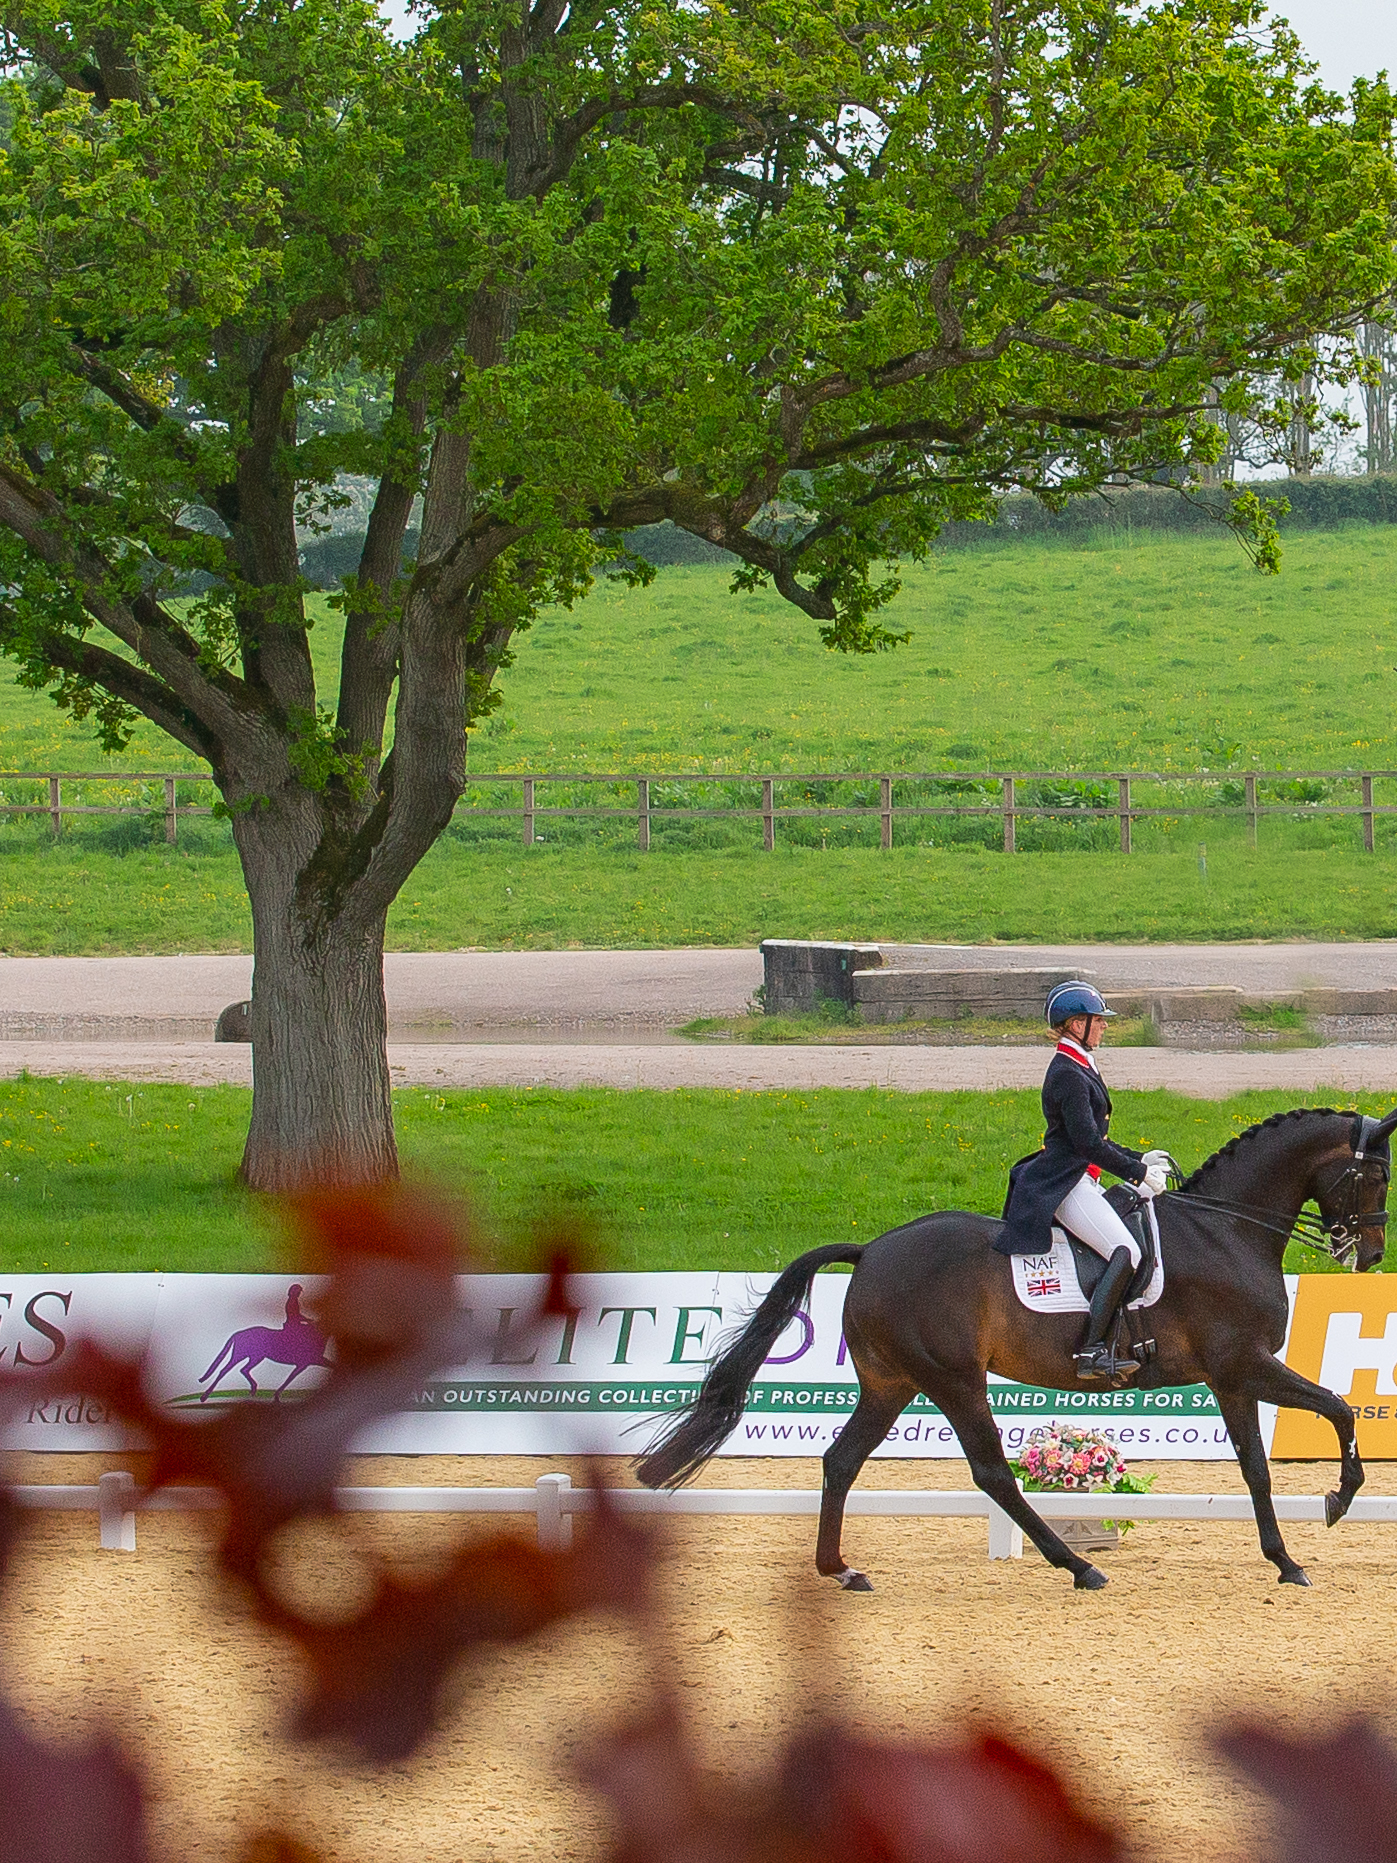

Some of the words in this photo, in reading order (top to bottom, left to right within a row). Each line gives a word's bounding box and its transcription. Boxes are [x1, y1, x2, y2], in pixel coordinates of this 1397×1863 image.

[1022, 1256, 1058, 1271] NAF
[450, 1306, 724, 1366] LITE
[443, 1389, 591, 1404] OUTSTANDING
[1054, 1392, 1135, 1408] HORSES
[1142, 1392, 1184, 1408] FOR
